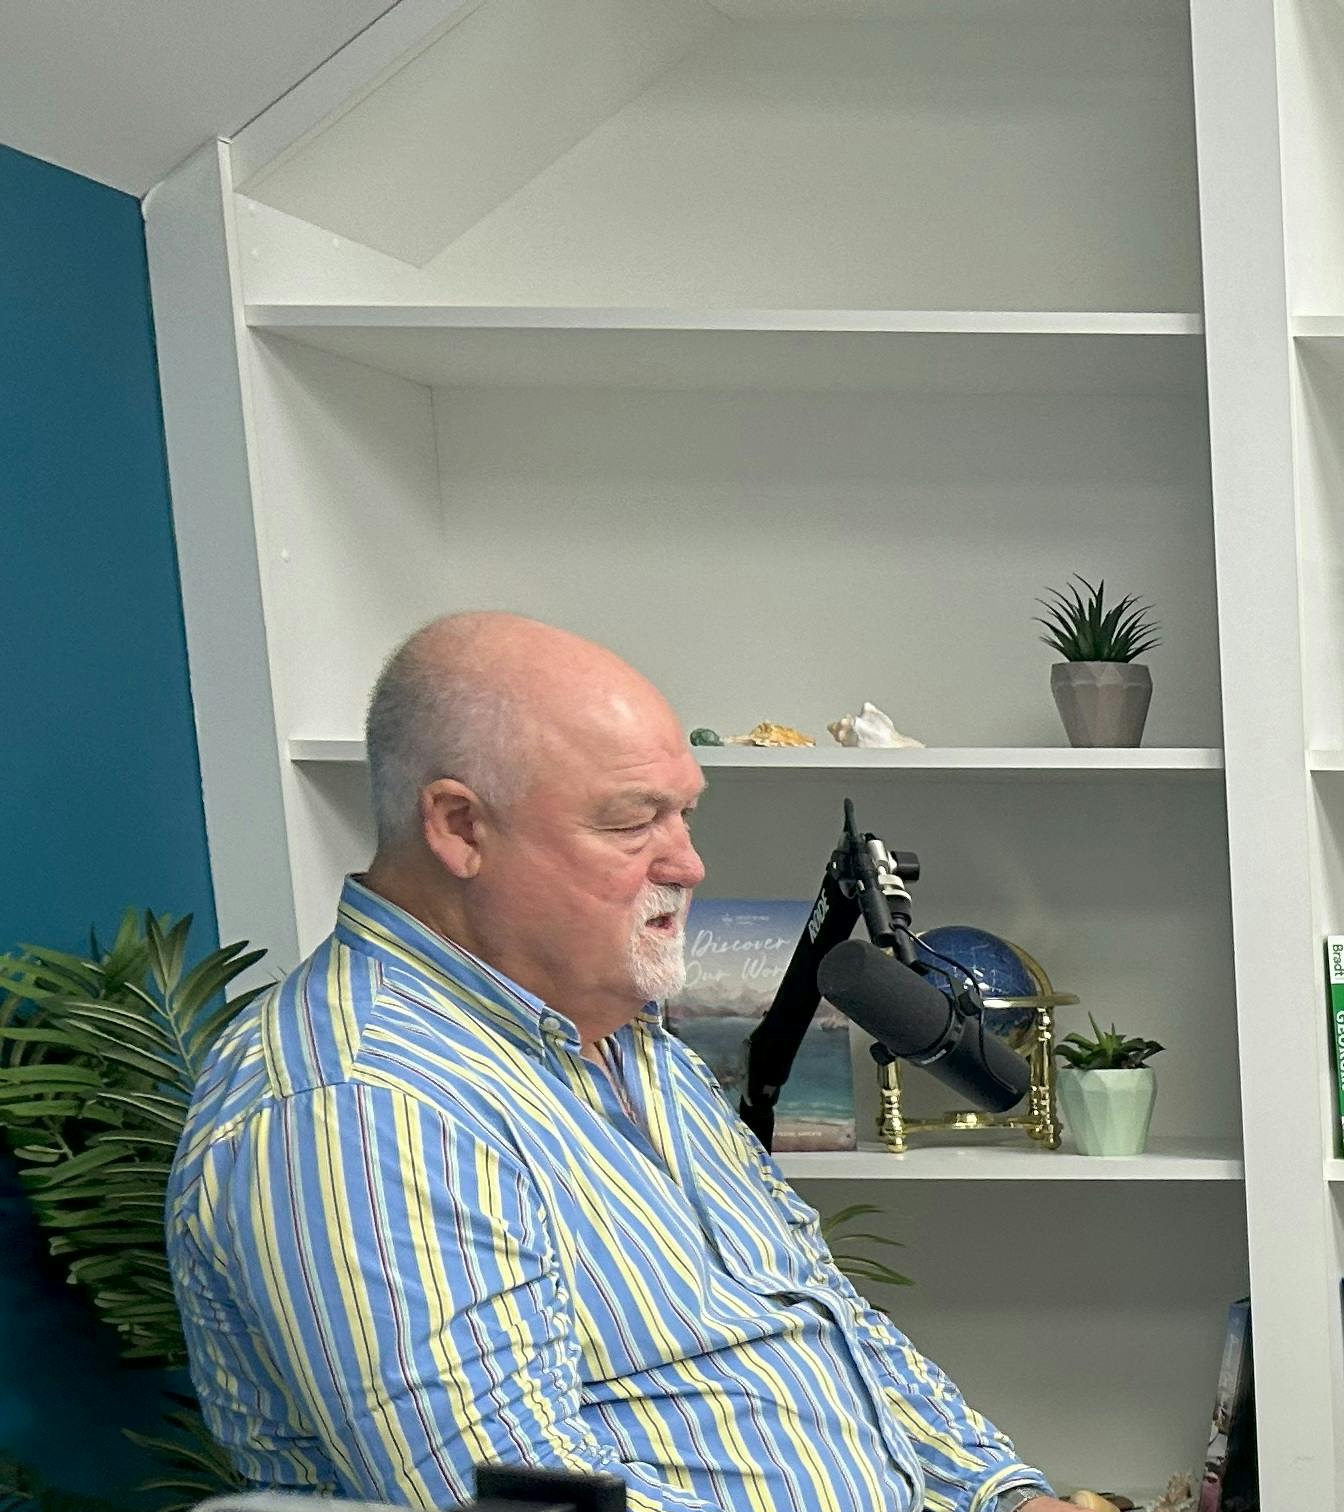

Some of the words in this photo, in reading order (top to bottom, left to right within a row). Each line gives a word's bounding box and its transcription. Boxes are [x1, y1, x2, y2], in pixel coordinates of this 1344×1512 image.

[691, 929, 791, 957] Discover
[1332, 943, 1344, 977] Bradt
[685, 960, 731, 988] Our
[742, 954, 787, 980] Wor
